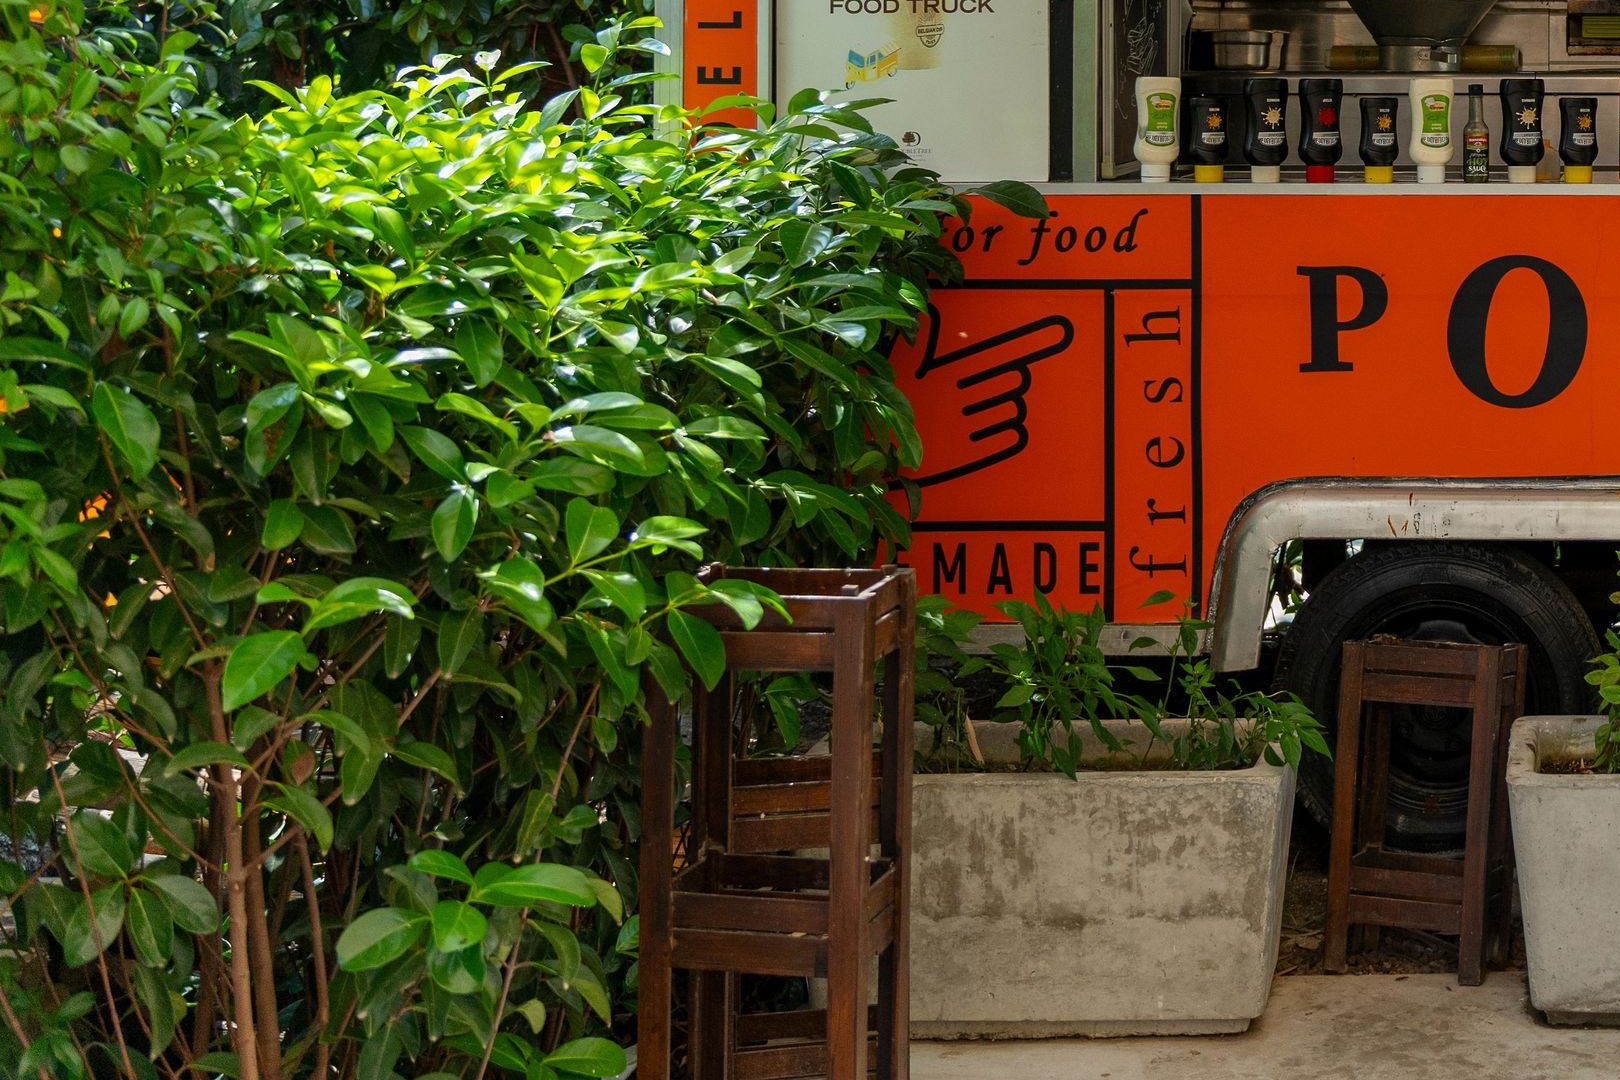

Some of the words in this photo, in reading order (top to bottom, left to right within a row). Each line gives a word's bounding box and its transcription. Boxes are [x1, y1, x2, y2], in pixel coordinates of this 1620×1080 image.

[937, 214, 1004, 253] or
[1017, 208, 1149, 266] food
[1123, 305, 1187, 578] fresh
[932, 542, 1100, 595] MADE
